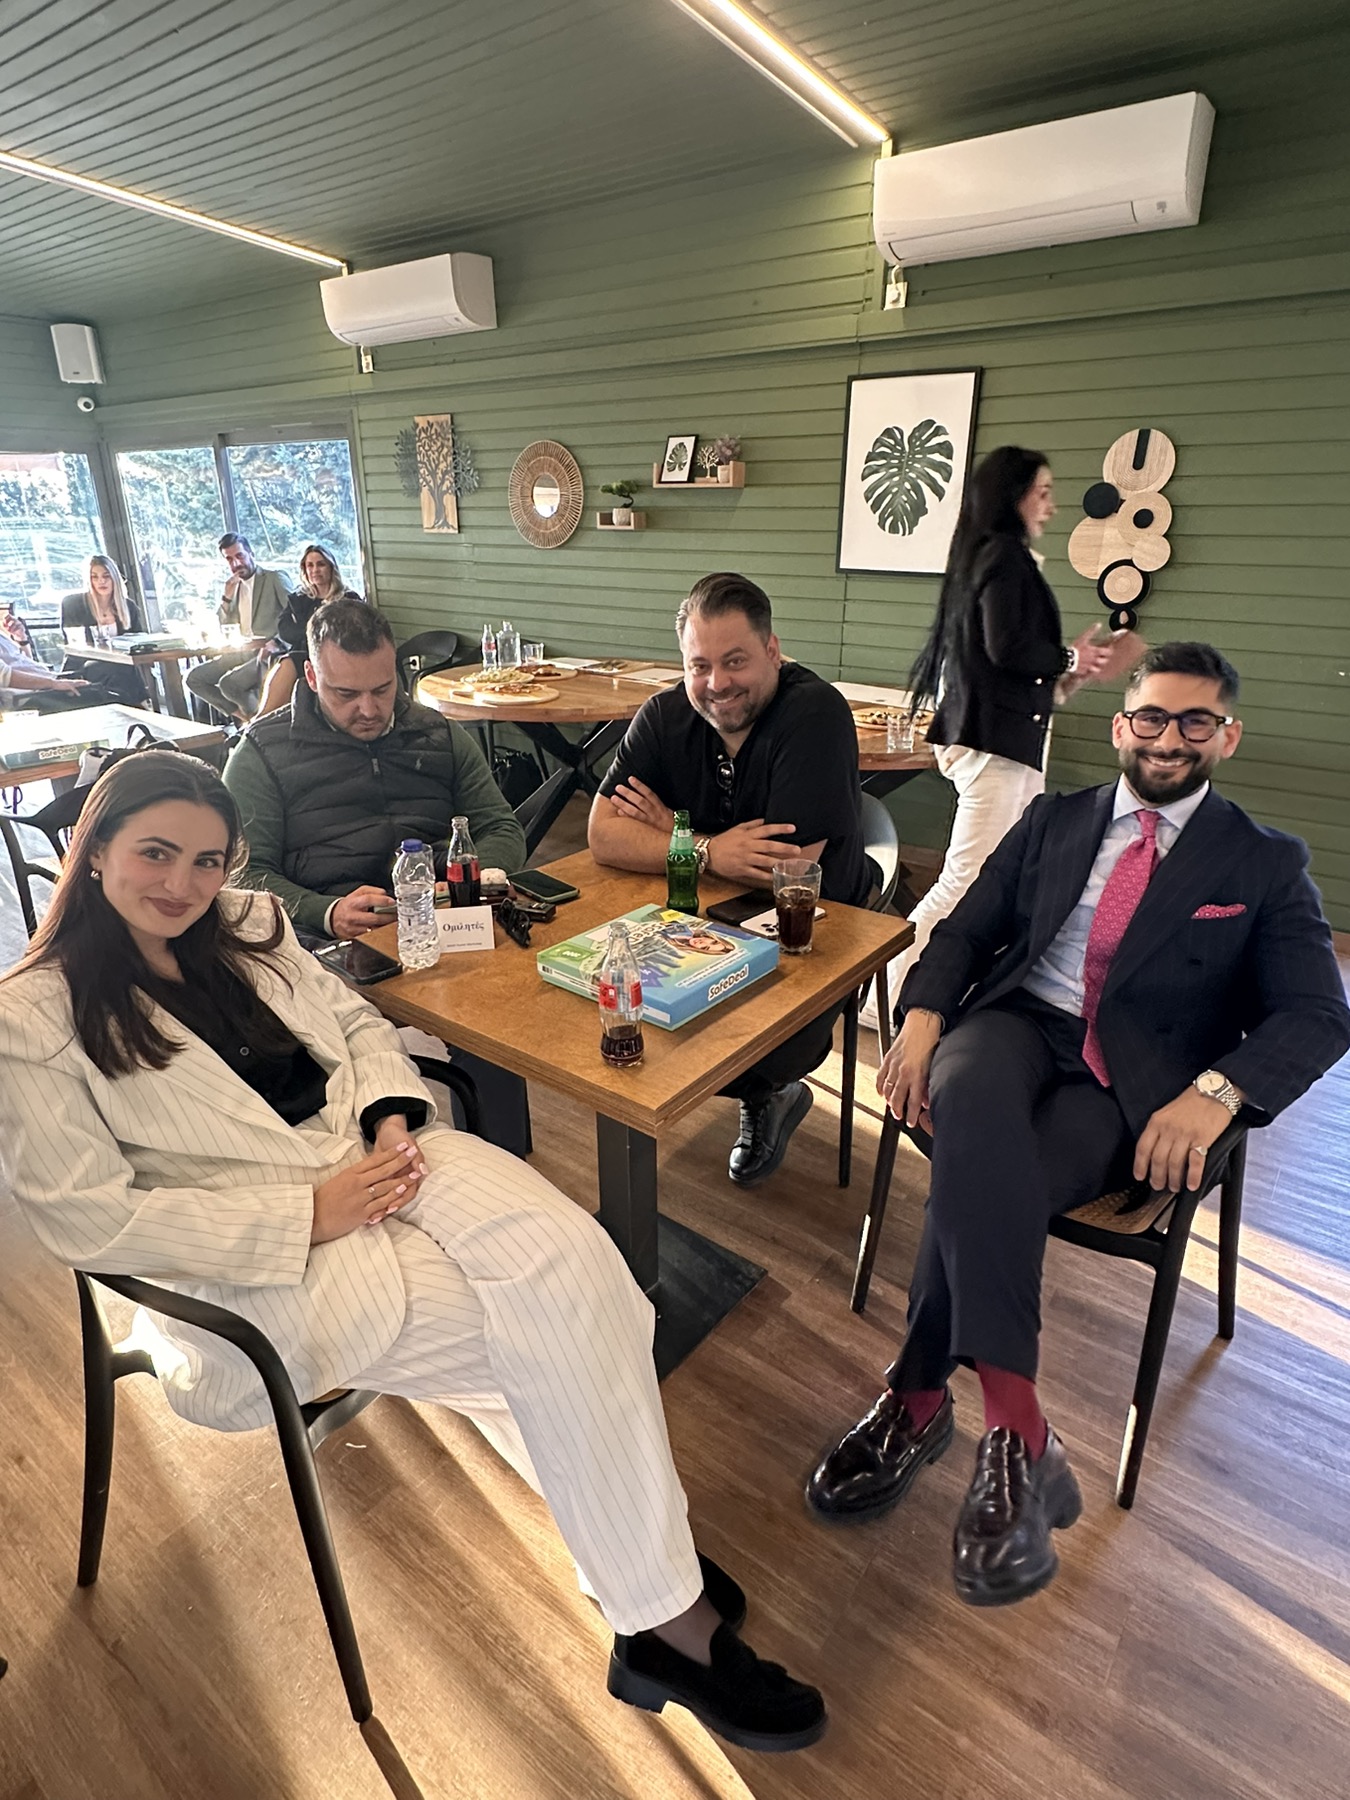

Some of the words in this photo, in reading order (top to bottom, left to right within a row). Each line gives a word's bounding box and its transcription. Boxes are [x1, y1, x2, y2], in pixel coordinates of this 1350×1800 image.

[40, 746, 77, 759] SafeDeal
[442, 921, 484, 933] Ομιλητές
[708, 964, 748, 1000] SafeDeal
